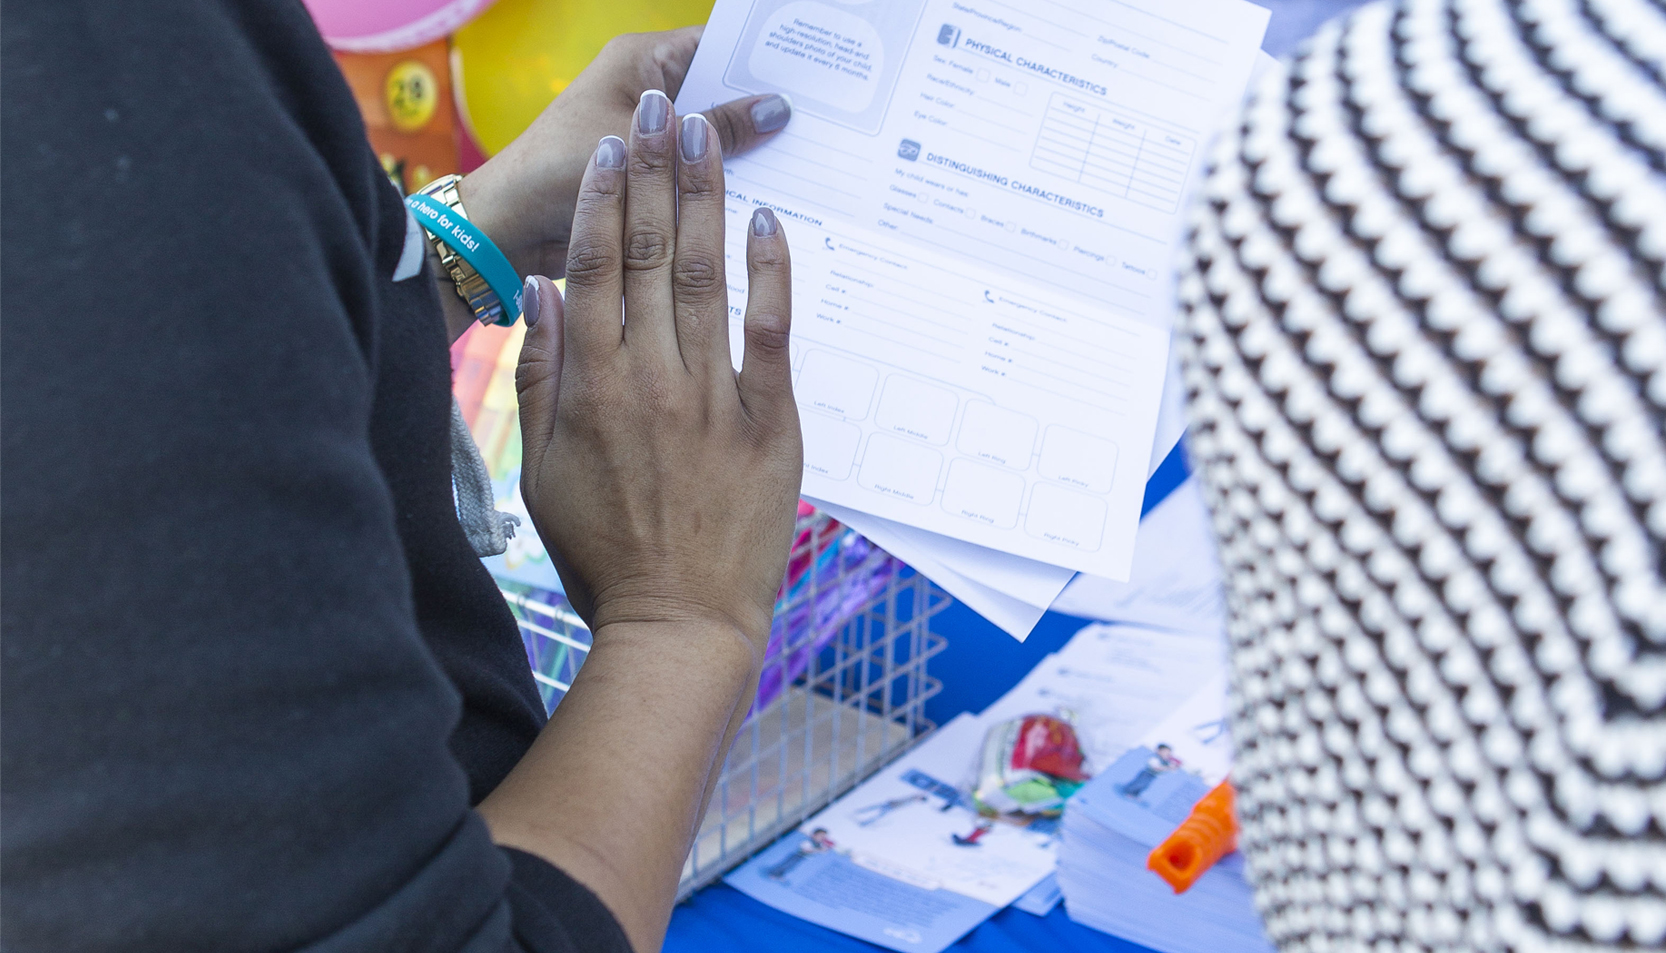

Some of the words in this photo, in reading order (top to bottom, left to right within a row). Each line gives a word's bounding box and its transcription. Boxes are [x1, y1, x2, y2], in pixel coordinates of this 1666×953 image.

[965, 38, 1013, 63] PHYSICAL
[1016, 57, 1108, 96] CHARACTERISTICS
[725, 189, 748, 202] ICAL
[926, 152, 1008, 186] DISTINGUISHING
[1011, 180, 1105, 218] CHARACTERISTICS
[417, 202, 438, 219] hero
[437, 214, 454, 230] for
[451, 225, 480, 252] kids!
